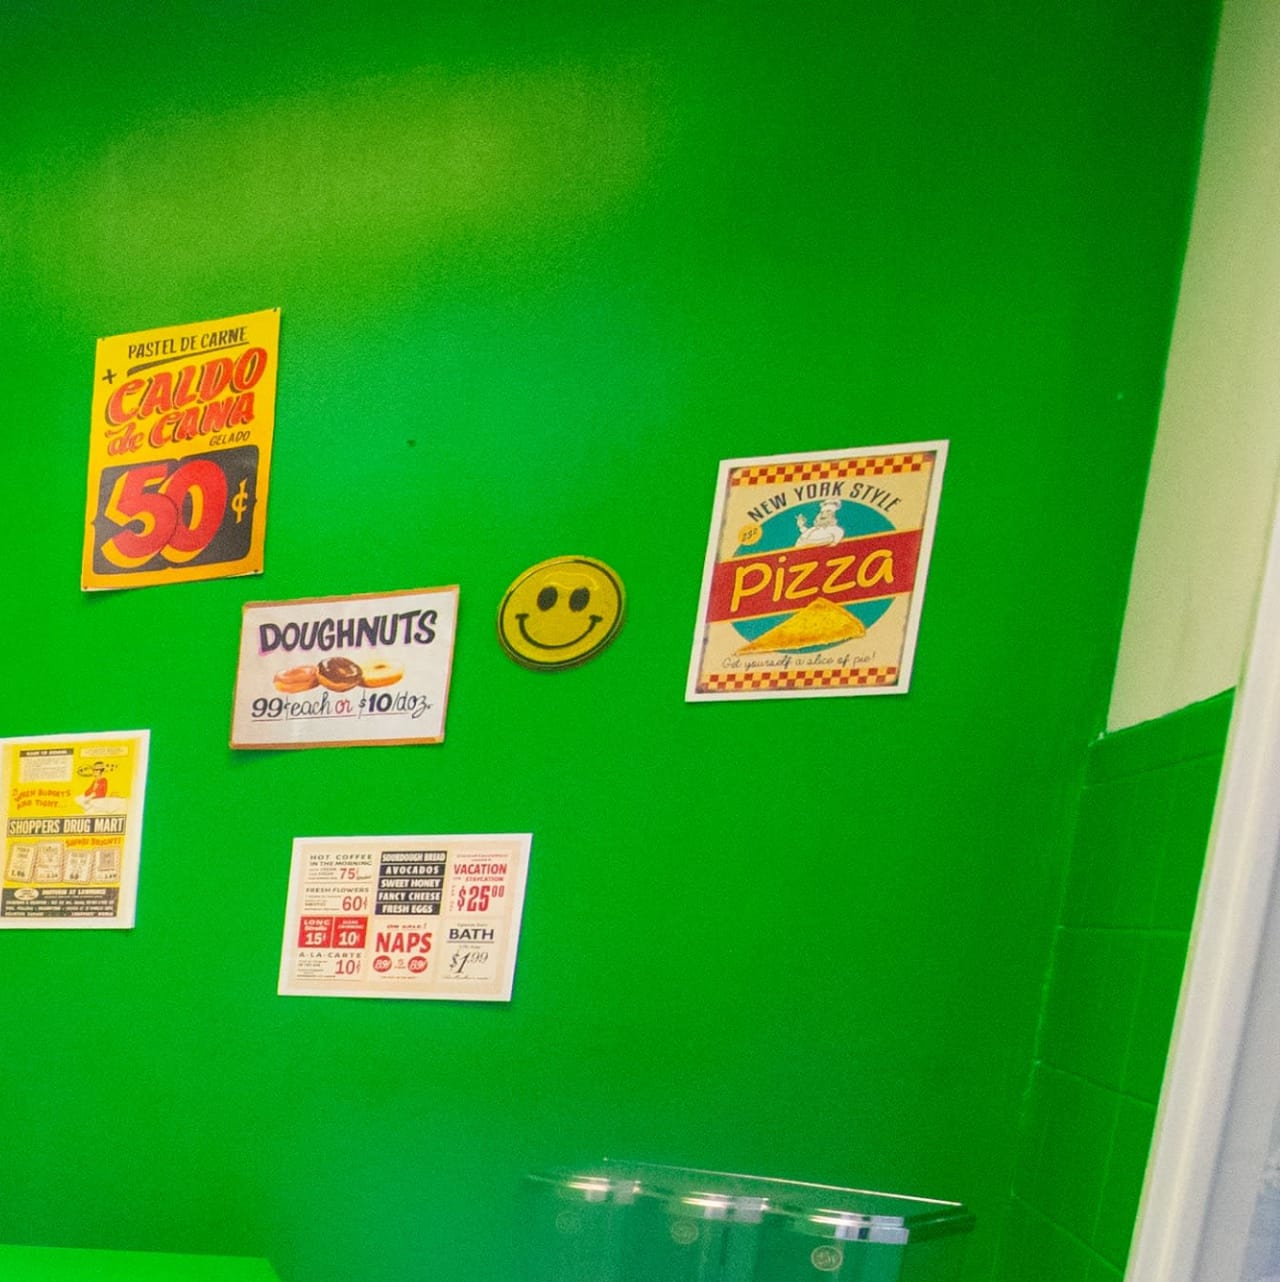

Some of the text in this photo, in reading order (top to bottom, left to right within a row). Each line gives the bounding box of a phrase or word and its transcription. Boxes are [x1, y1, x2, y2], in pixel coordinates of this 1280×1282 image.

[128, 326, 248, 359] PASTEL DE CARNE
[105, 347, 268, 426] CALDO
[105, 391, 255, 456] de CANA
[208, 430, 251, 447] GELADO
[746, 481, 902, 522] NEW YORK STYLE
[730, 549, 894, 612] Pizza
[258, 609, 438, 656] DOUGHNUTS
[744, 654, 792, 671] yourself
[290, 691, 331, 717] each
[334, 699, 352, 714] or
[9, 817, 125, 835] SHOPPERS DRUG MART
[385, 865, 440, 875] AVOCADOS
[453, 863, 508, 875] VACATION
[381, 879, 410, 888] SWEET
[410, 878, 442, 888] HONEY
[378, 891, 441, 901] FANCY CHEESE
[381, 904, 434, 914] FRESH EGGS
[375, 932, 433, 954] NAPS
[449, 928, 495, 940] BATH
